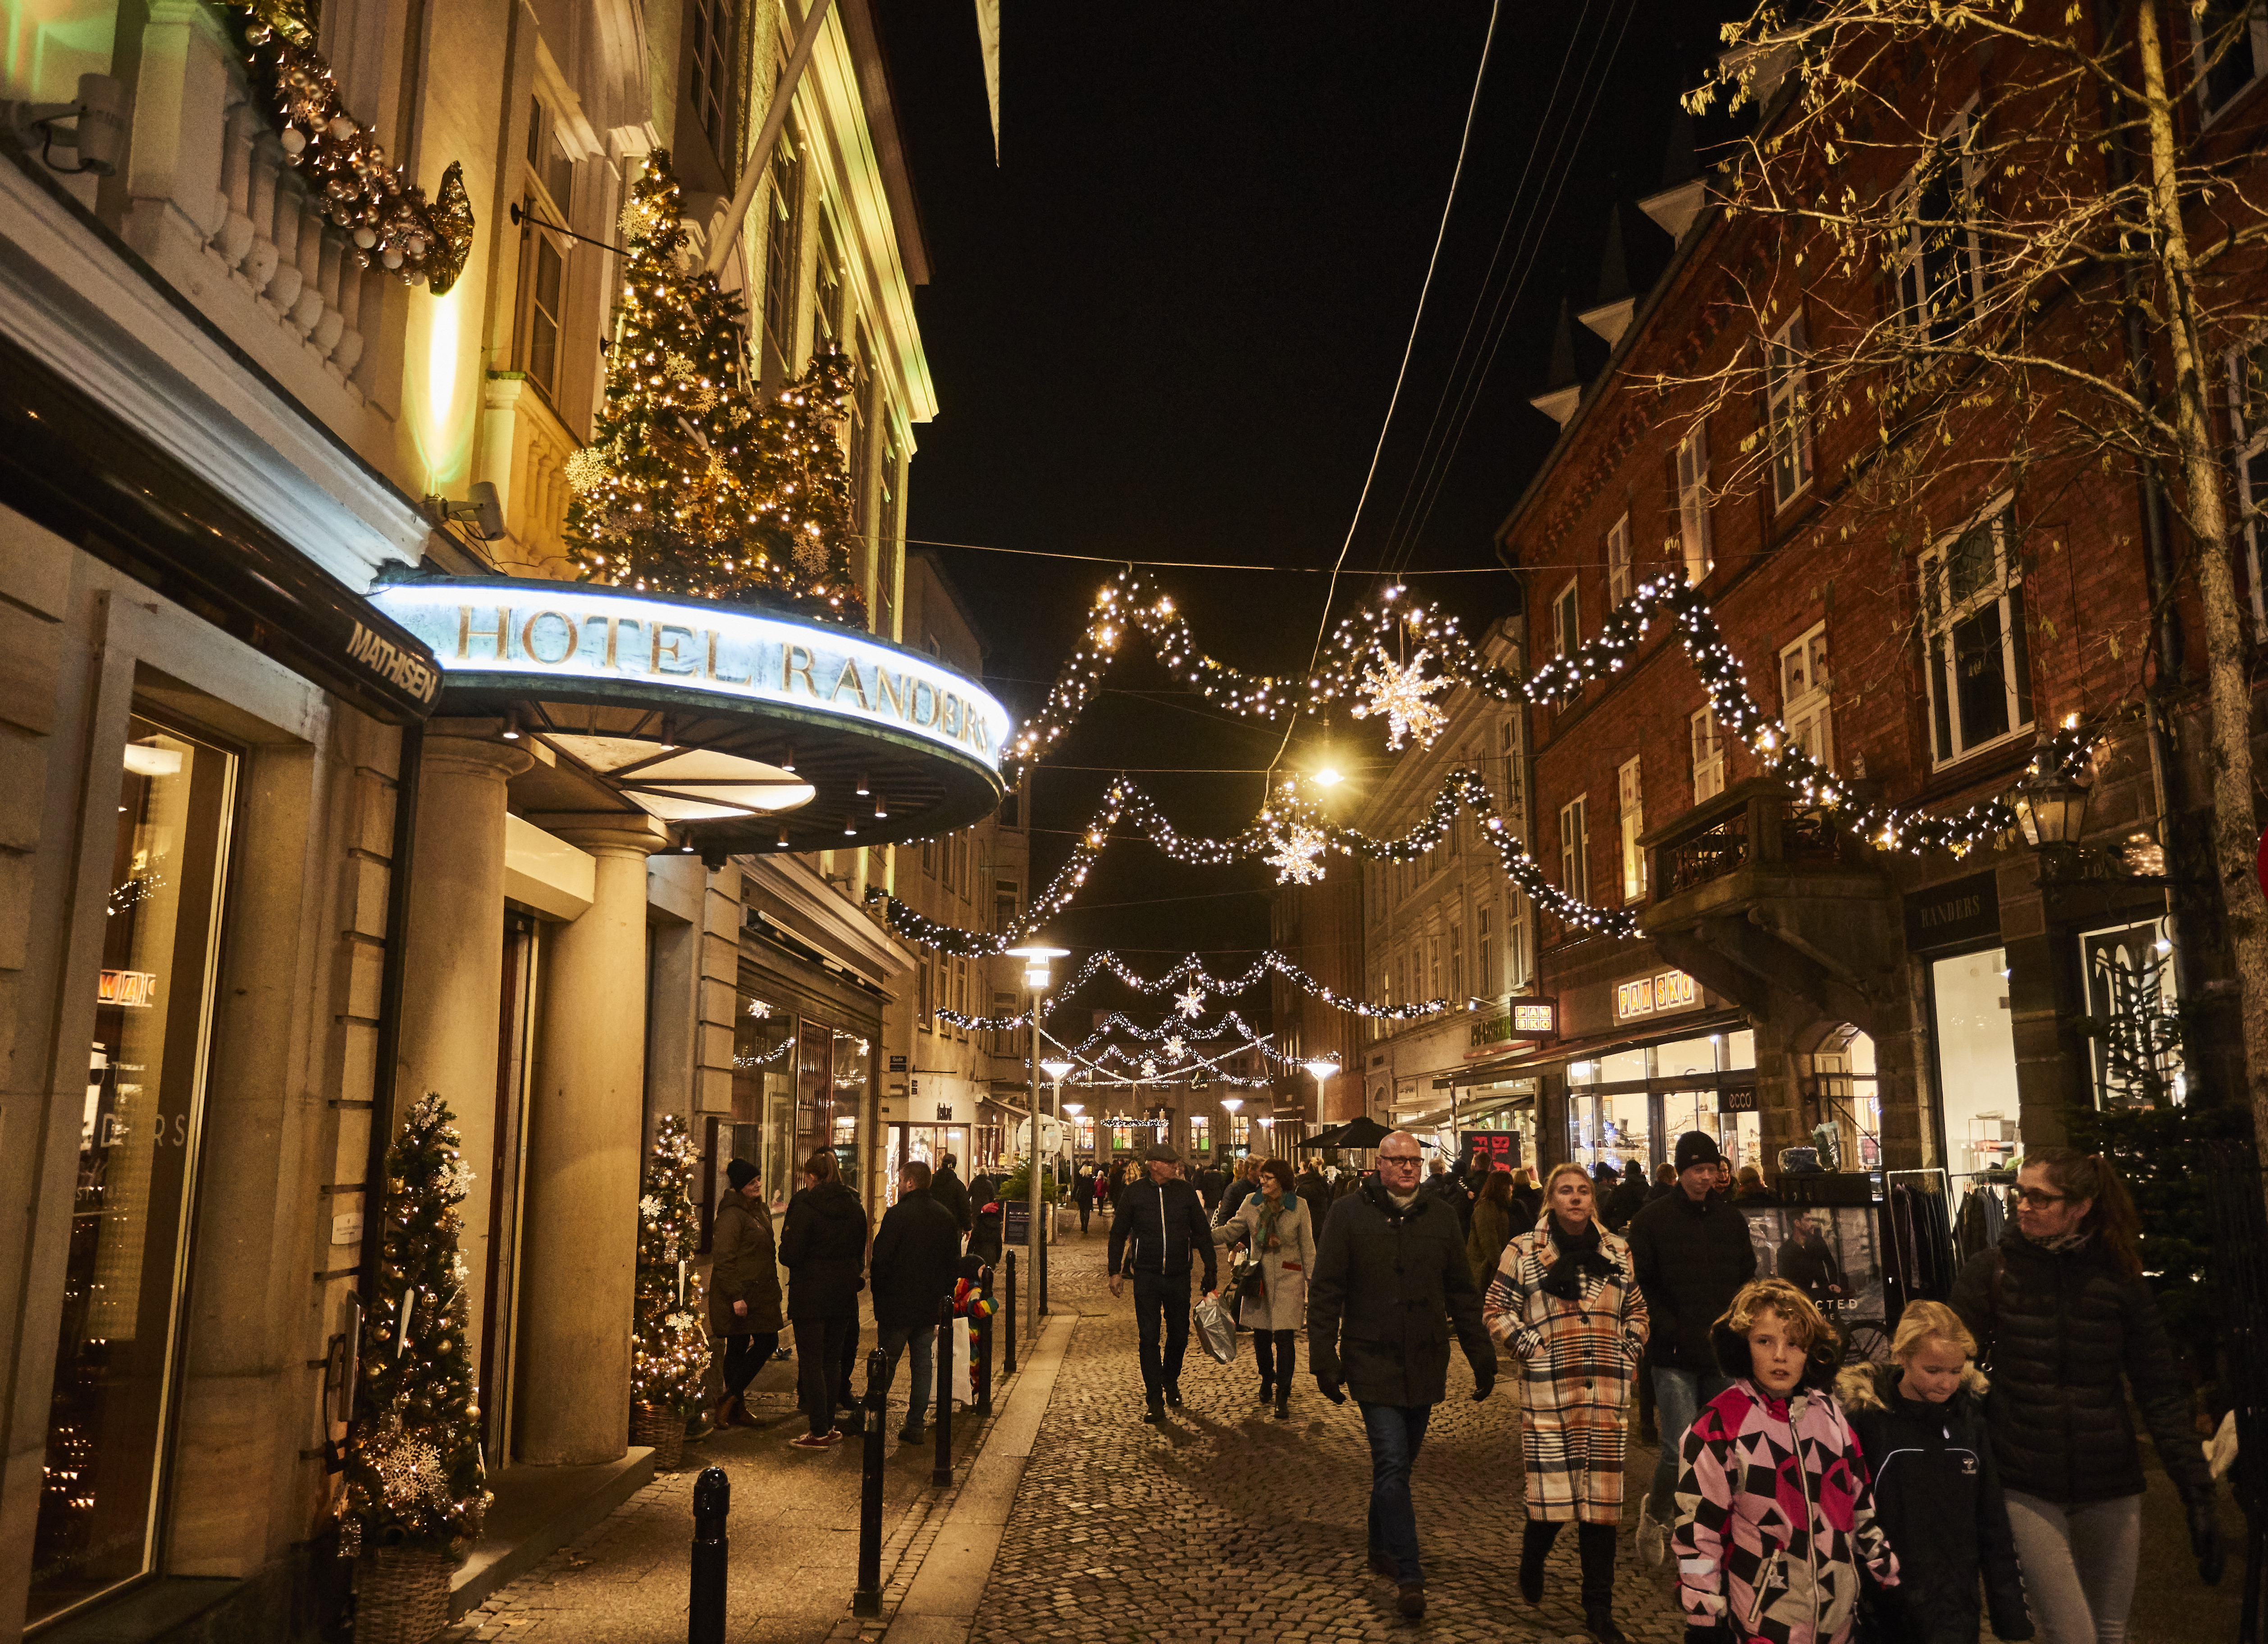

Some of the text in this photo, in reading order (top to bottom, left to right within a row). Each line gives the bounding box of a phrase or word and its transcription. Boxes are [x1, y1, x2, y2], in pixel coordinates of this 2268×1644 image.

[346, 620, 437, 703] MATHISEN
[454, 605, 988, 755] HOTEL RANDERS
[1920, 894, 1980, 928] RANDERS
[1619, 972, 1692, 1015] PAW SKO
[1516, 1007, 1550, 1017] PAW
[1516, 1019, 1551, 1029] SKO
[1729, 1092, 1752, 1109] ecco
